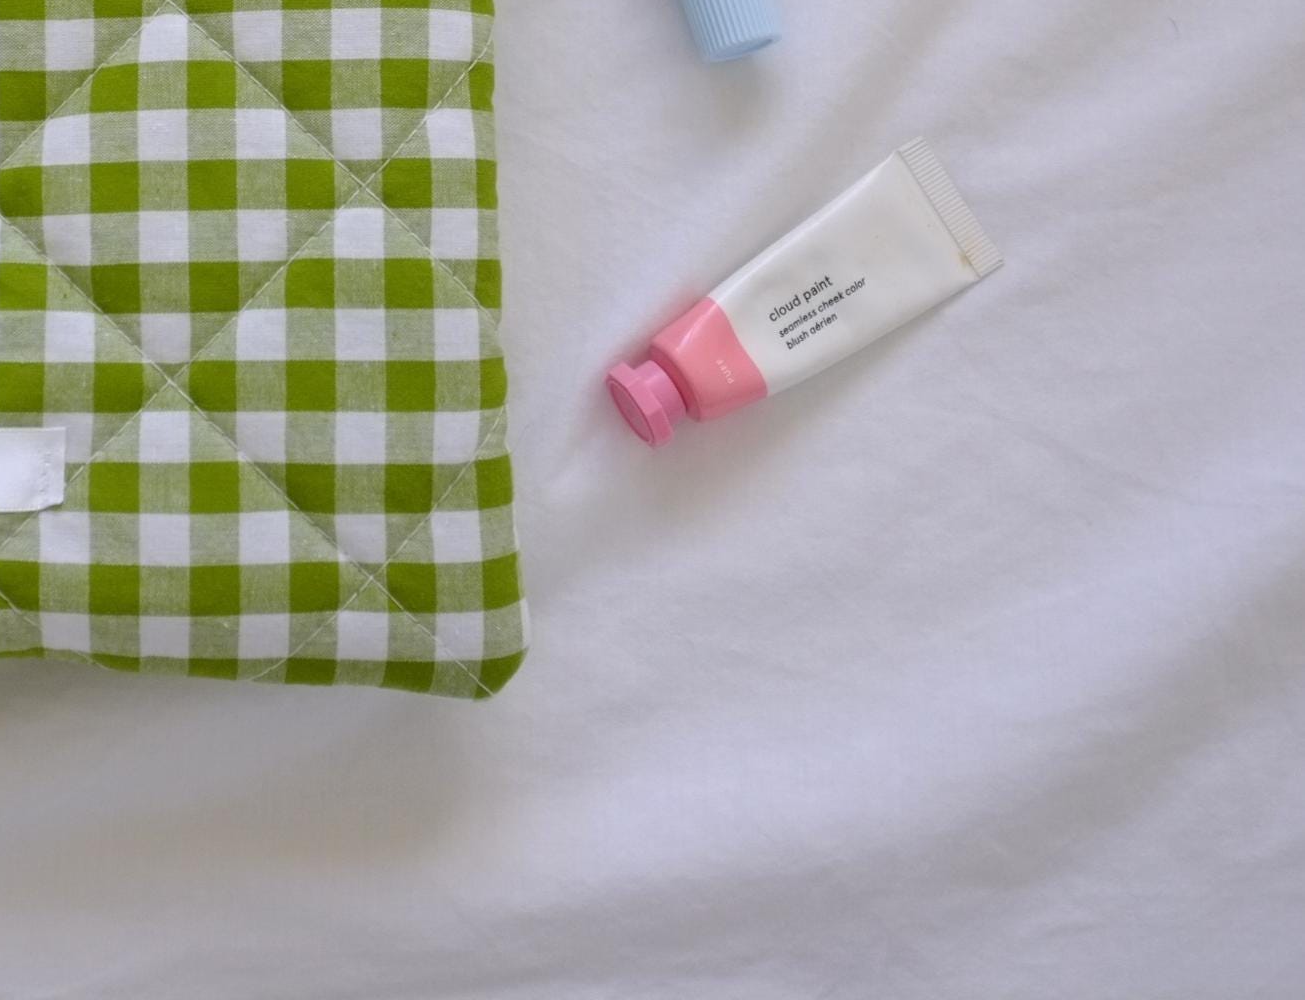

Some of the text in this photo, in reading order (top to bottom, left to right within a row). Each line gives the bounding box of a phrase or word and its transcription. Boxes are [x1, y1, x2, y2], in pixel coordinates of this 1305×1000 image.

[769, 274, 834, 322] cloud paint
[779, 277, 866, 338] seamless cheek color
[786, 312, 838, 350] blush aérien
